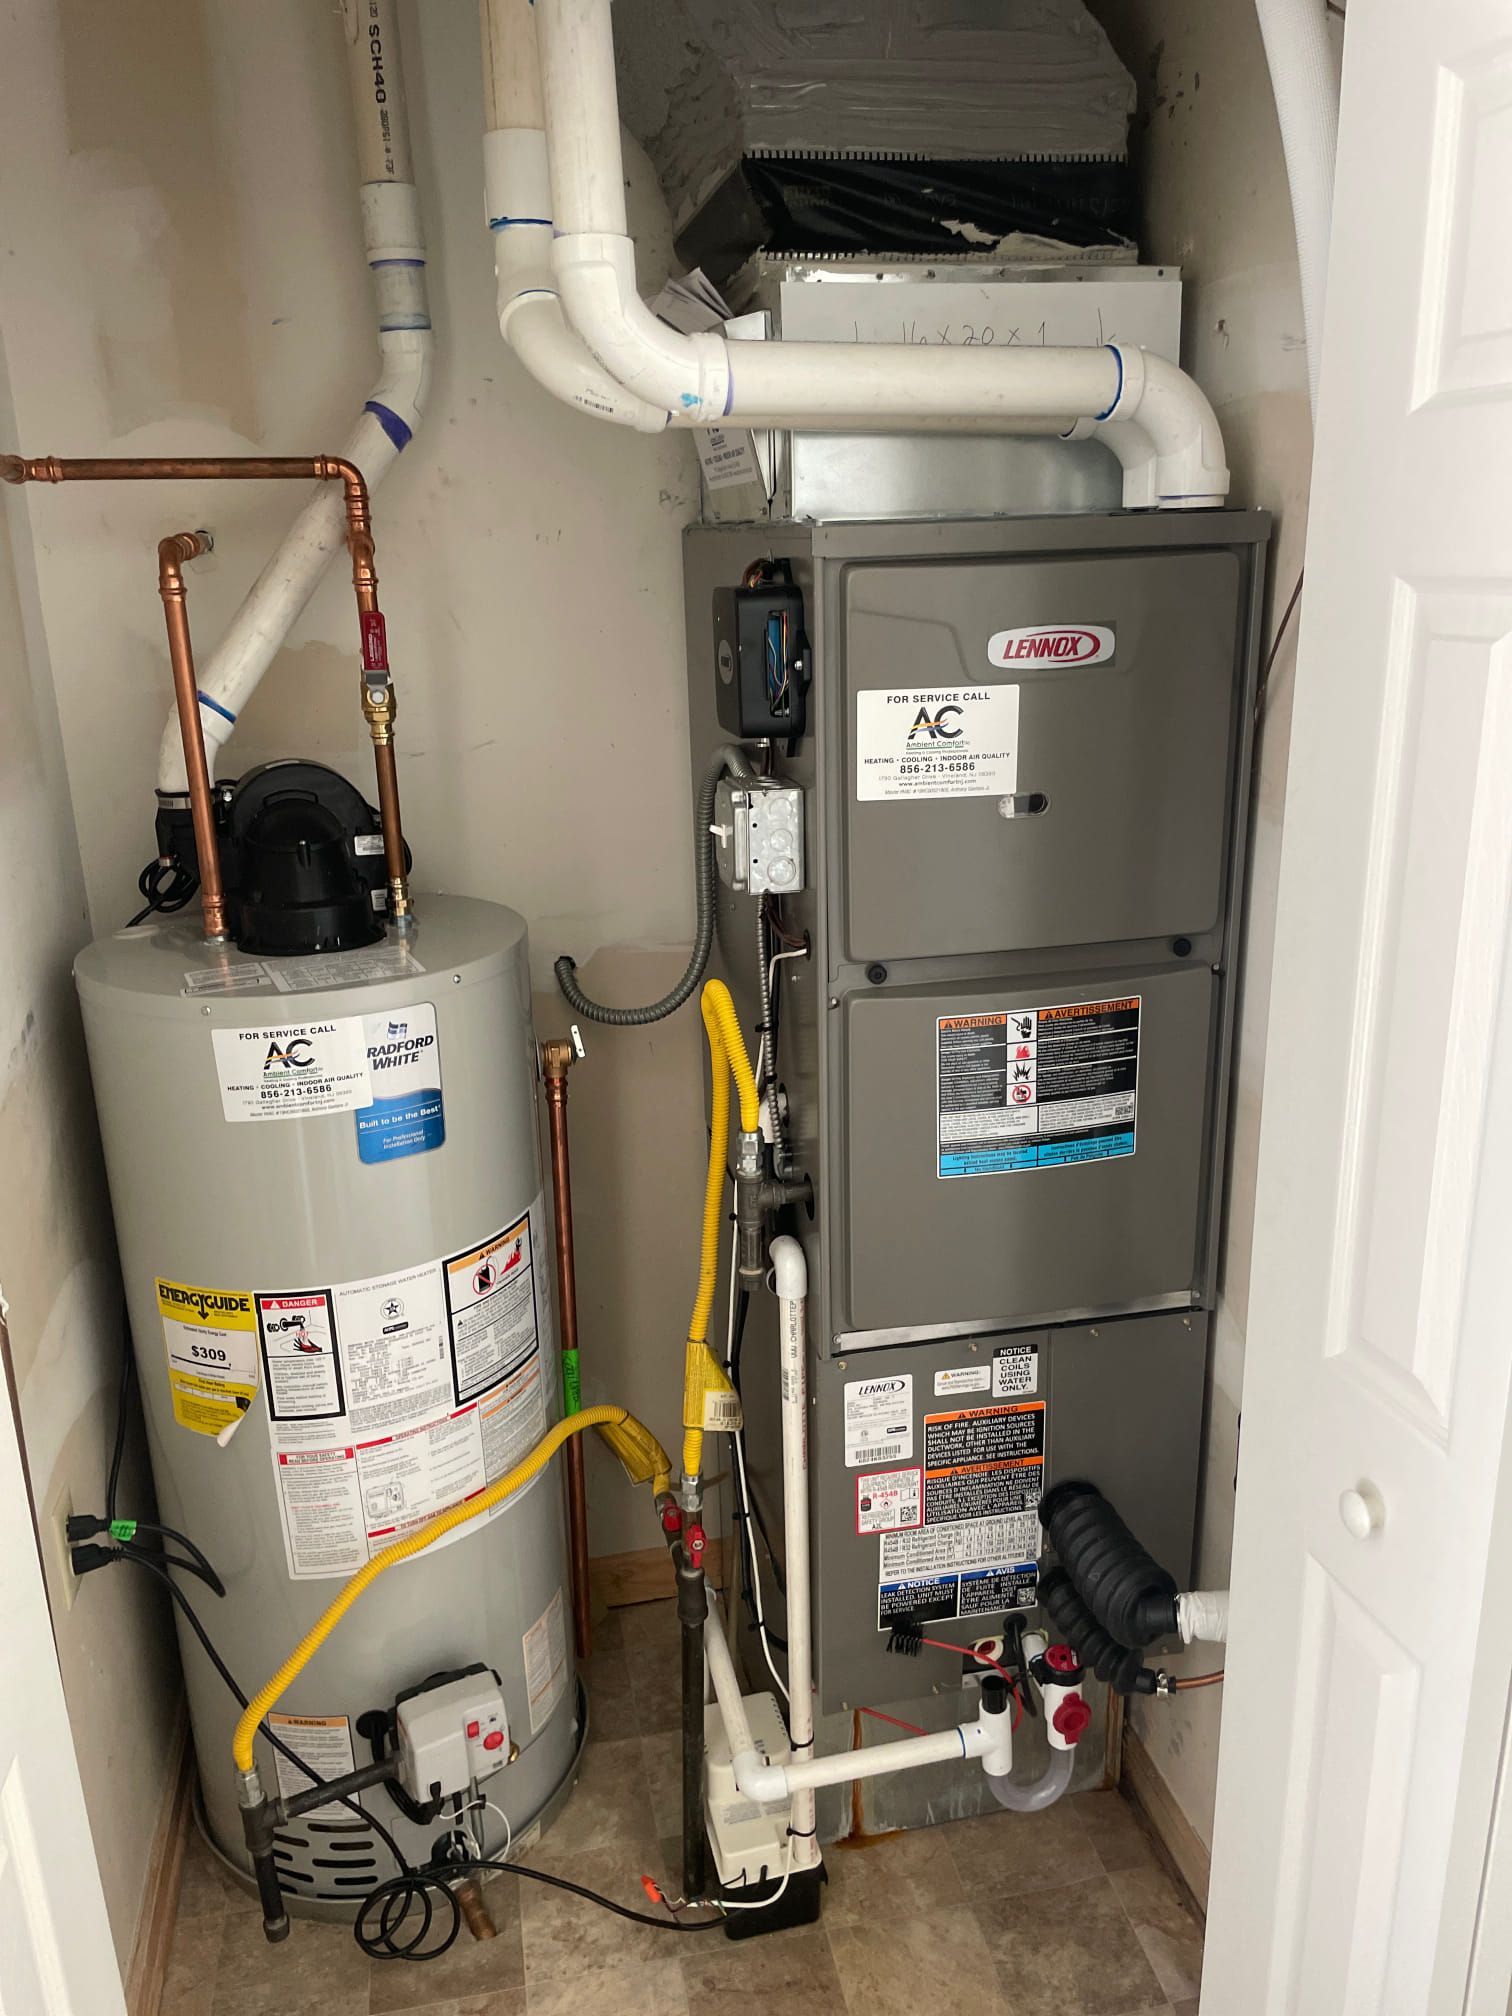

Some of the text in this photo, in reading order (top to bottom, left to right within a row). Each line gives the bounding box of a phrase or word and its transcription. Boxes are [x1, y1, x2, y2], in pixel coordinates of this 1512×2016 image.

[369, 24, 387, 104] SCH40
[962, 325, 995, 345] 20
[1002, 636, 1083, 660] LENNOX
[887, 691, 990, 704] FOR SERVICE CALL
[907, 705, 964, 740] AC
[906, 739, 964, 748] Ambient Comfort
[864, 757, 894, 765] HEATING
[940, 754, 966, 762] INDOOR
[982, 752, 1010, 760] QUALITY
[900, 762, 976, 774] 856-213-6586
[1054, 1000, 1134, 1018] AVERTISSEMENT
[953, 1016, 1002, 1028] WARNING
[239, 1025, 336, 1040] FOR SERVICE CALL
[263, 1038, 315, 1070] AC
[373, 1051, 420, 1070] WHITE
[336, 1073, 364, 1081] QUALITY
[260, 1085, 332, 1099] 856-213-6586
[360, 1106, 438, 1128] Built to be the Best
[338, 1286, 370, 1296] AUTOMATIC
[282, 1299, 318, 1308] DANGER
[191, 1345, 226, 1361] $309
[1000, 1346, 1032, 1356] NOTICE
[999, 1356, 1032, 1365] CLEAN
[1001, 1363, 1030, 1371] COILS
[1000, 1370, 1030, 1378] USING
[998, 1377, 1032, 1385] WATER
[858, 1381, 897, 1396] LENNOX
[968, 1405, 1018, 1417] WARNING
[972, 1417, 1006, 1426] AUXILIARY
[1007, 1413, 1035, 1422] DEVICES
[927, 1431, 950, 1439] WHICH
[976, 1423, 1005, 1432] IGNITION
[1006, 1420, 1035, 1429] SOURCES
[927, 1437, 948, 1445] SHALL
[976, 1429, 1011, 1439] INSTALLED
[965, 1439, 986, 1447] OTHER
[1005, 1433, 1036, 1442] AUXILIARY
[927, 1451, 951, 1459] DEVICES
[951, 1448, 970, 1456] LISTED
[960, 1459, 1024, 1473] AVERTISSEMENT
[995, 1567, 1014, 1575] AVIS
[896, 1586, 929, 1595] DETECTION
[932, 1583, 954, 1591] SYSTEM
[907, 1577, 939, 1588] NOTICE
[934, 1588, 953, 1596] MUST
